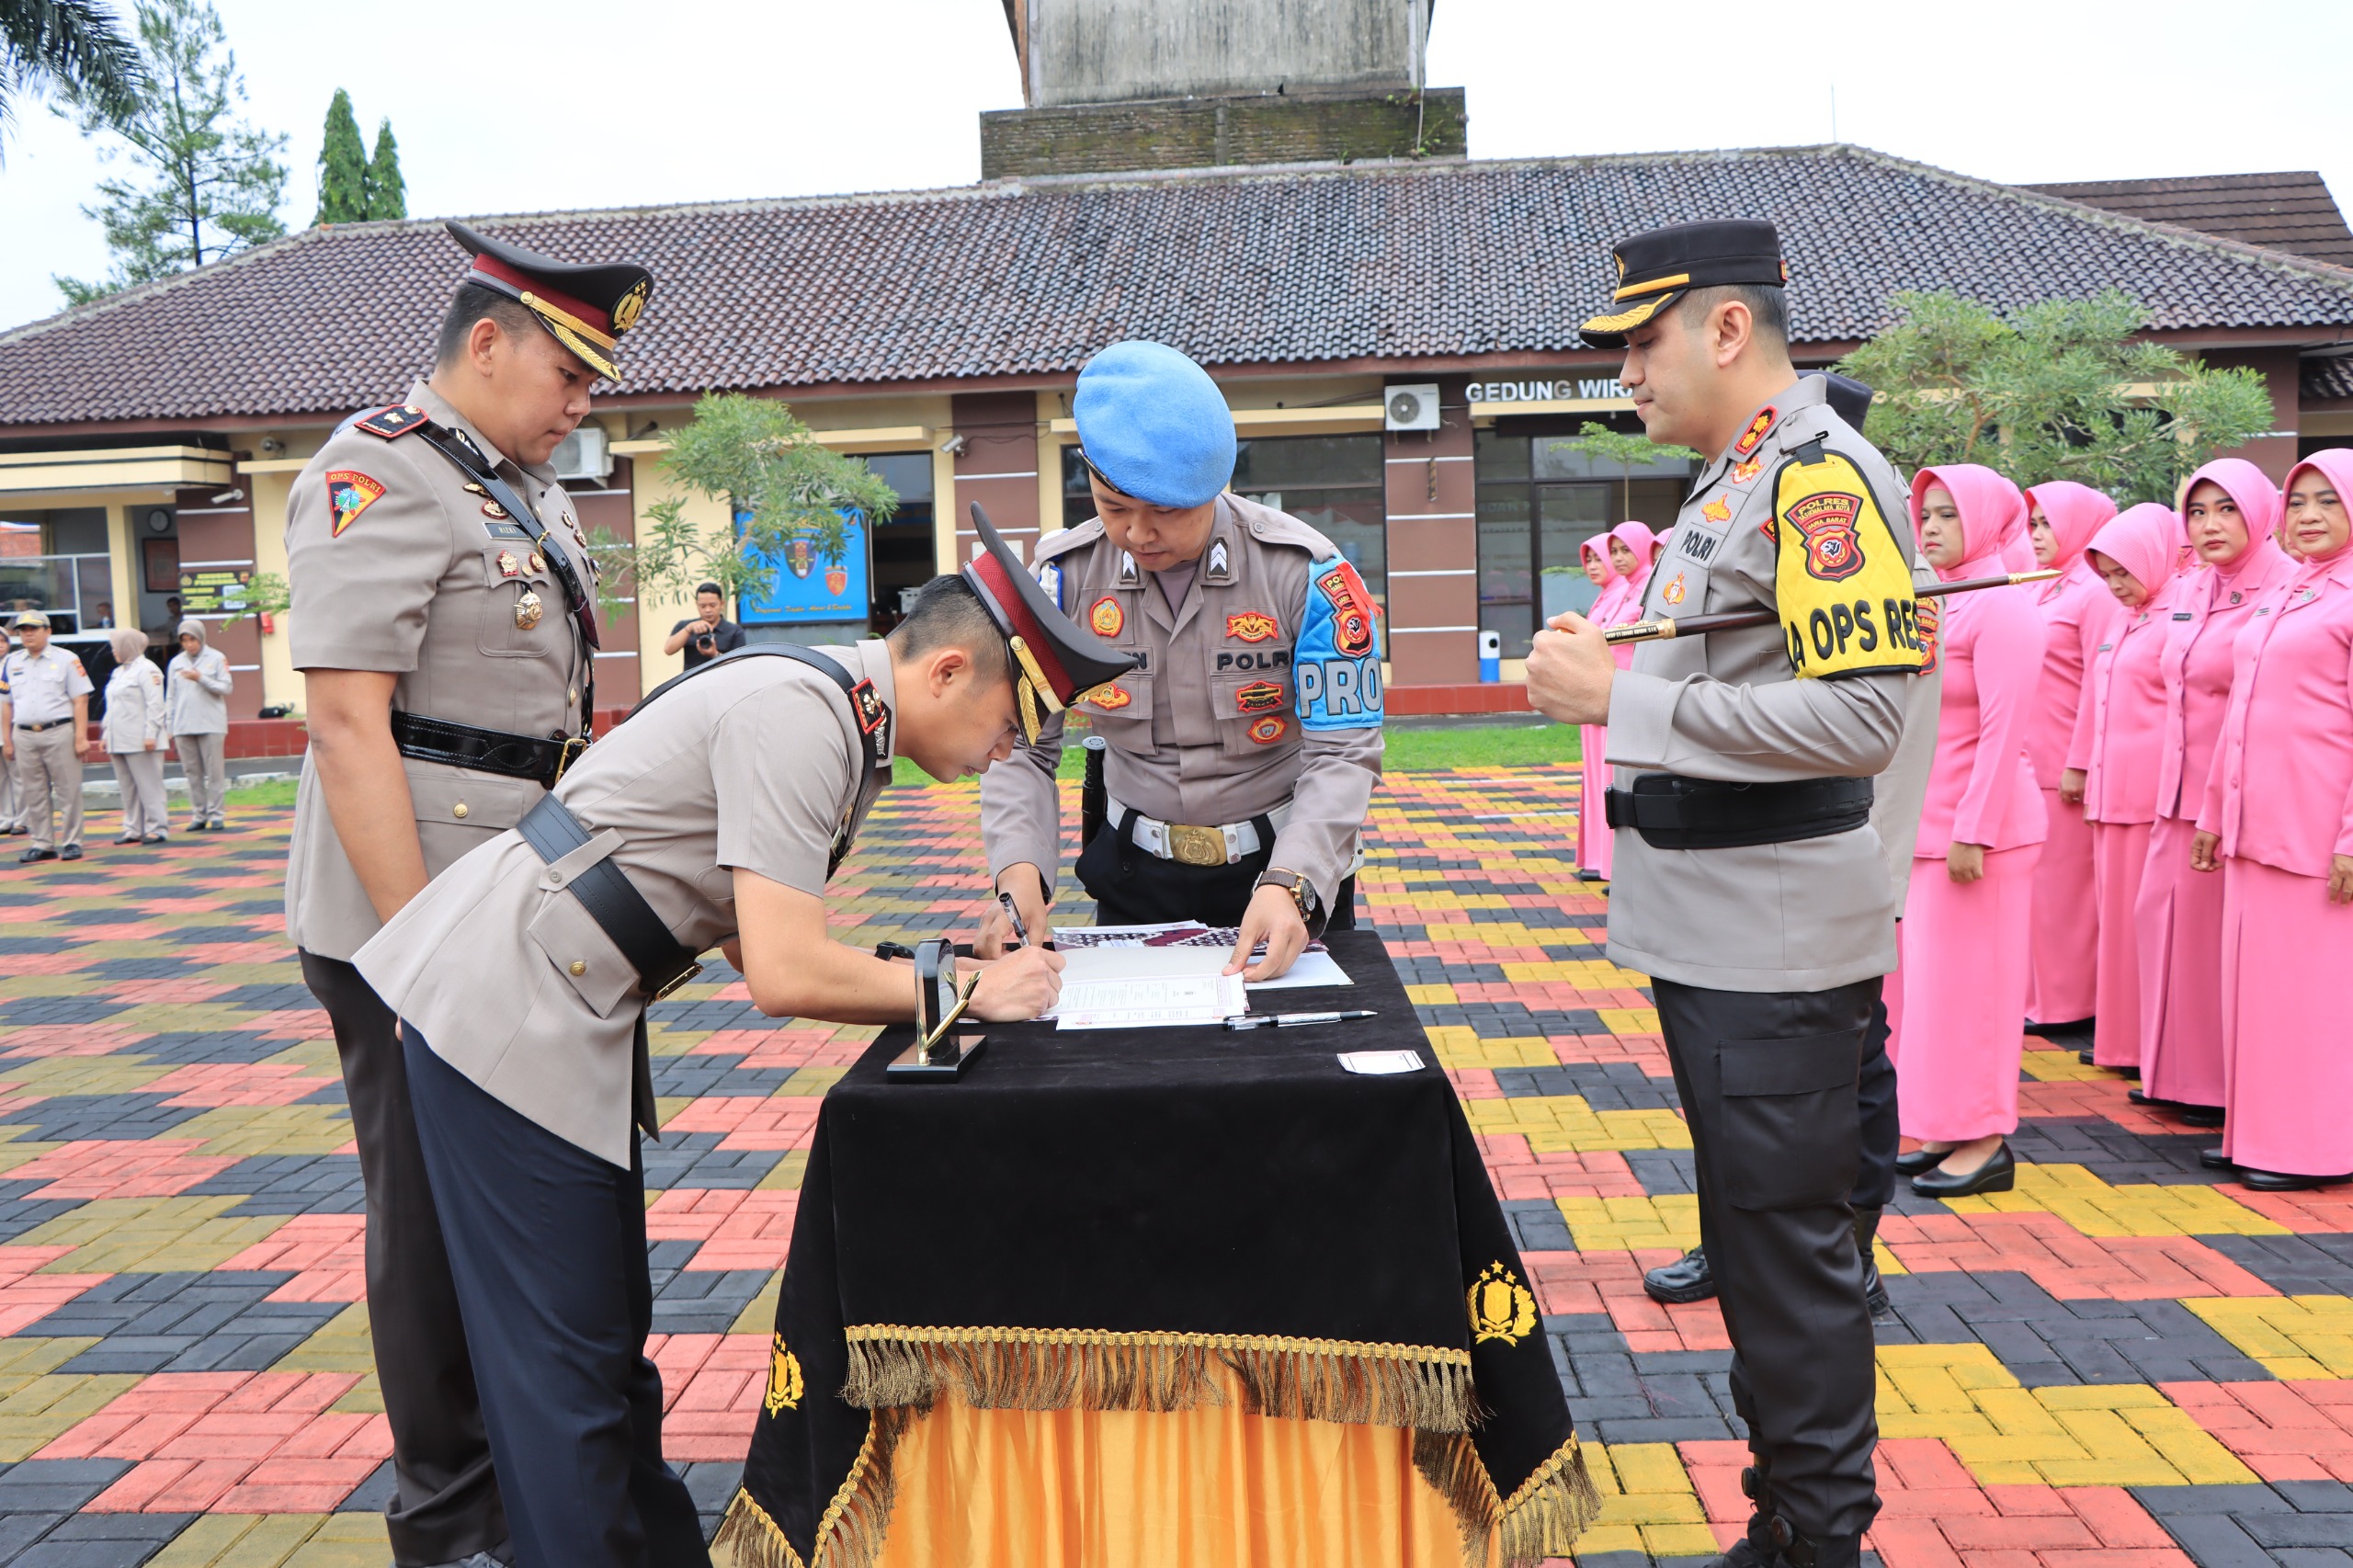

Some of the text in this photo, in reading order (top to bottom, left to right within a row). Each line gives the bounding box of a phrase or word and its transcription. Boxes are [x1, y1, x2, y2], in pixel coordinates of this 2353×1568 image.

[1465, 378, 1633, 403] GEDUNG WIR
[331, 472, 381, 493] OPS POLRI
[1798, 497, 1849, 515] POLRES
[1798, 505, 1834, 521] TASIKMALAYA
[1807, 518, 1824, 530] JAWA
[1679, 529, 1717, 562] POLRI
[1325, 574, 1345, 588] POL
[1810, 599, 1878, 661] OPS
[1217, 650, 1291, 671] POLR
[1298, 656, 1382, 720] PRO
